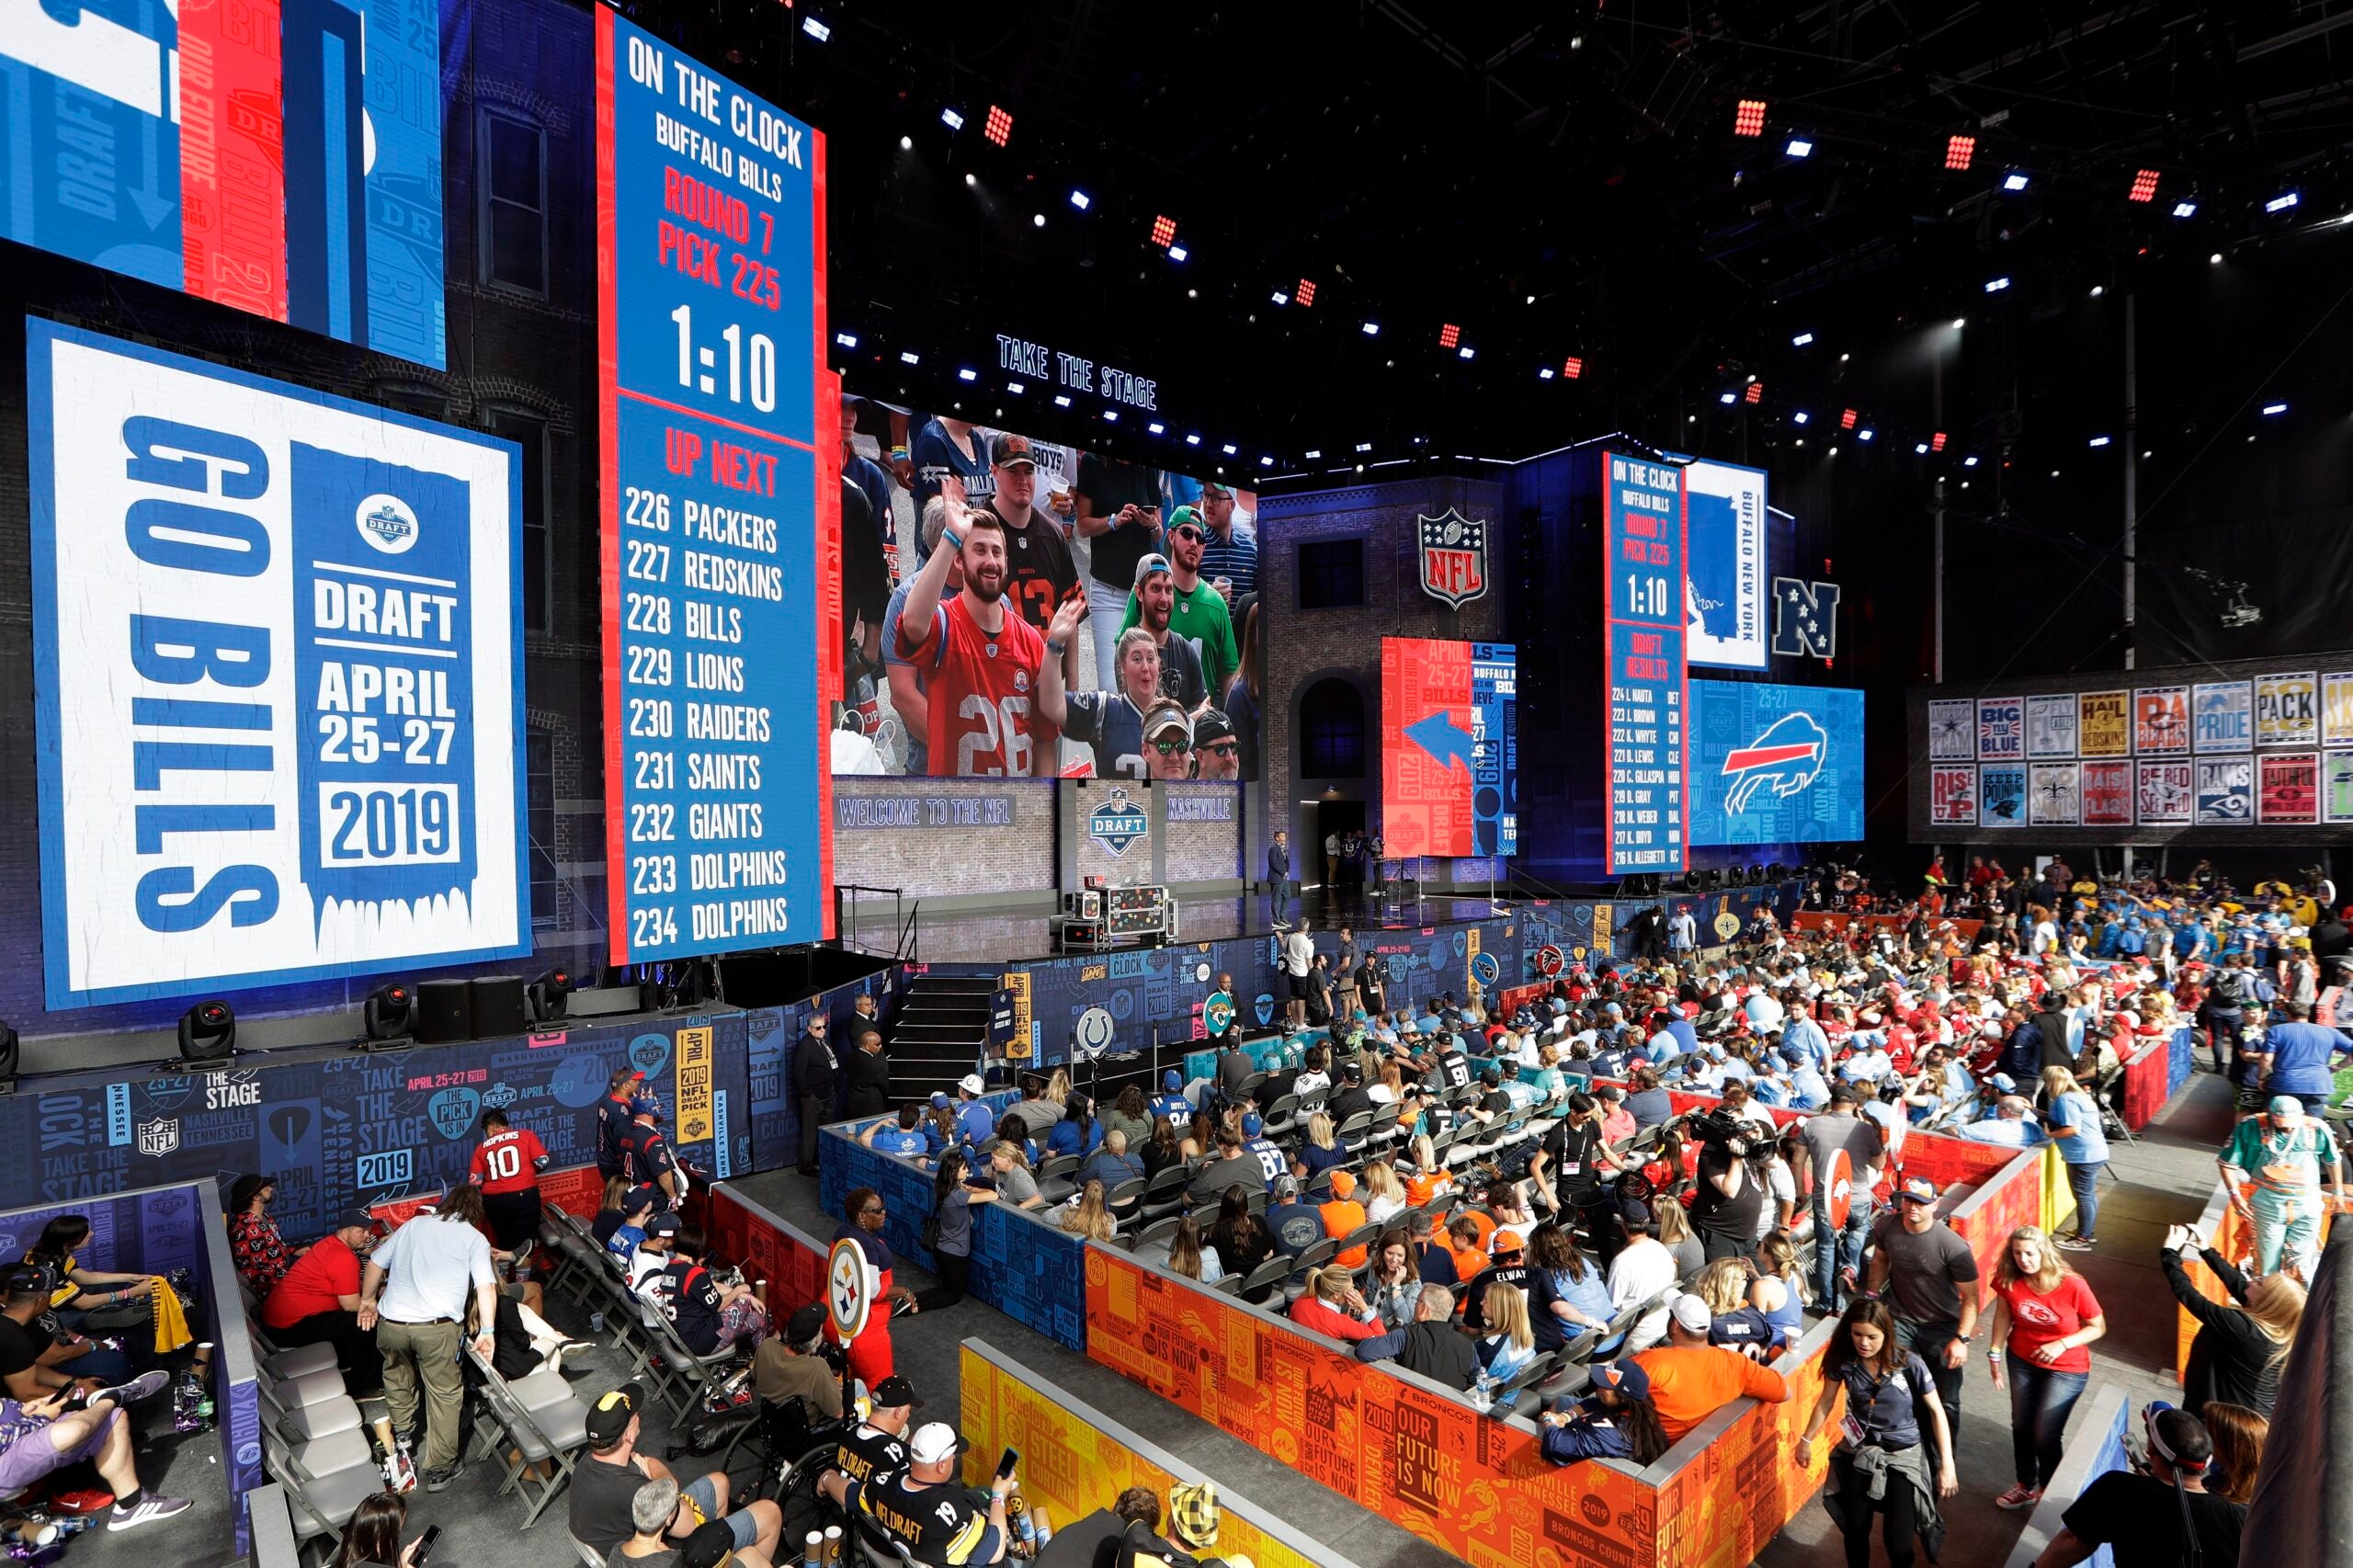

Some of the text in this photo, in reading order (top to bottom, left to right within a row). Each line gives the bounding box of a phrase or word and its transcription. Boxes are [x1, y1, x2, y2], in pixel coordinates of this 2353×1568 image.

[629, 36, 802, 170] ON THE CLOCK
[655, 111, 782, 203] BUFFALO BILLS
[664, 165, 774, 255] ROUND 7
[657, 220, 780, 311] PICK 225
[671, 304, 776, 414] 1:10
[996, 333, 1157, 411] TAKE THE STAGE
[665, 426, 779, 497] UP NEXT
[1613, 460, 1677, 492] ON THE CLOCK
[1622, 490, 1669, 513] BUFFALO BILLS
[369, 519, 408, 533] DRAFT
[625, 486, 778, 553] 226 PACKERS
[1625, 513, 1666, 540] ROUND 7
[1623, 539, 1669, 566] PICK 225
[1742, 491, 1754, 642] BUFFALO NEW YORK
[627, 540, 782, 601] 227 REDSKINS
[1427, 550, 1482, 596] NFL
[1007, 579, 1054, 641] 13
[1628, 574, 1667, 617] 1:10
[313, 578, 458, 643] DRAFT
[627, 593, 742, 643] 228 BILLS
[1772, 576, 1840, 658] N
[1428, 642, 1468, 663] APRIL
[1631, 632, 1662, 655] DRAFT
[122, 415, 279, 934] GO BILLS
[627, 645, 745, 693] 229 LIONS
[1427, 664, 1468, 687] 25-27
[1627, 658, 1668, 680] RESULTS
[316, 659, 456, 718] APRIL
[1423, 688, 1469, 703] BILLS
[629, 699, 770, 743] 230 RAIDERS
[1981, 707, 2020, 722] BIG
[2082, 700, 2126, 719] HAIL
[2137, 694, 2187, 722] DA
[2259, 692, 2313, 722] PACK
[958, 694, 1031, 777] 26
[2082, 731, 2126, 747] REDSKINS
[2137, 722, 2186, 748] BEARS
[2197, 710, 2249, 740] PRIDE
[319, 714, 456, 766] 25-27
[1981, 736, 2020, 752] BLUE
[633, 751, 761, 791] 231 SAINTS
[1614, 749, 1625, 763] 221
[1635, 749, 1654, 763] LEWIS
[1668, 751, 1679, 764] CLE
[1934, 771, 1973, 806] RISE
[1983, 773, 2024, 784] KEEP
[2140, 767, 2189, 788] BE RED
[2201, 765, 2249, 788] RAMS
[839, 798, 1010, 826] WELCOME TO THE NFL
[1112, 799, 1125, 810] NFL
[1168, 798, 1231, 820] NASHVILLE
[331, 789, 450, 860] 2019
[631, 802, 763, 843] 232 GIANTS
[1095, 819, 1142, 832] DRAFT
[632, 850, 786, 895] 233 DOLPHINS
[632, 897, 788, 949] 234 DOLPHINS
[1113, 960, 1142, 975] CLOCK
[1147, 986, 1170, 994] DRAFT
[1149, 996, 1168, 1014] 2019
[688, 1032, 702, 1063] APRIL
[205, 1071, 228, 1087] THE
[360, 1065, 404, 1092] TAKE
[407, 1069, 486, 1091] APRIL 25-27 2019
[682, 1066, 707, 1085] 2019
[206, 1082, 261, 1110] STAGE
[445, 1089, 462, 1101] THE
[681, 1085, 708, 1097] NFL
[681, 1095, 708, 1103] DRAFT
[356, 1092, 395, 1122] THE
[440, 1101, 469, 1120] PICK
[681, 1102, 708, 1111] PICK
[1170, 1102, 1187, 1110] DOYLE
[358, 1115, 427, 1153] STAGE
[445, 1120, 465, 1135] IS IN
[717, 1096, 725, 1146] NASHVILLE
[143, 1132, 175, 1151] NFL
[483, 1131, 519, 1148] HOPKINS
[361, 1152, 409, 1186] 2019
[485, 1145, 520, 1181] 10
[1256, 1151, 1287, 1181] 87
[1495, 1269, 1527, 1282] ELWAY
[1156, 1324, 1171, 1341] OUR
[1171, 1330, 1198, 1357] FUTURE
[1727, 1324, 1750, 1335] DAVIS
[1156, 1341, 1198, 1375] IS NOW
[1275, 1343, 1315, 1365] BRONCOS
[1309, 1400, 1331, 1413] MILE
[1309, 1406, 1332, 1421] HIGH
[1312, 1394, 1329, 1407] THE
[1412, 1393, 1472, 1424] BRONCOS
[1309, 1414, 1328, 1426] CITY
[1366, 1403, 1393, 1434] 2019
[1397, 1407, 1431, 1443] OUR
[883, 1442, 904, 1463] 19
[1030, 1430, 1076, 1485] STEEL
[1397, 1433, 1461, 1483] FUTURE
[1030, 1462, 1075, 1507] CURTAIN
[1365, 1444, 1382, 1511] DENVER
[1397, 1458, 1461, 1508] IS NOW
[1511, 1458, 1577, 1501] NASHVILLE
[1511, 1471, 1577, 1517] TENNESSEE
[935, 1501, 958, 1527] 19
[1584, 1500, 1608, 1521] 2019
